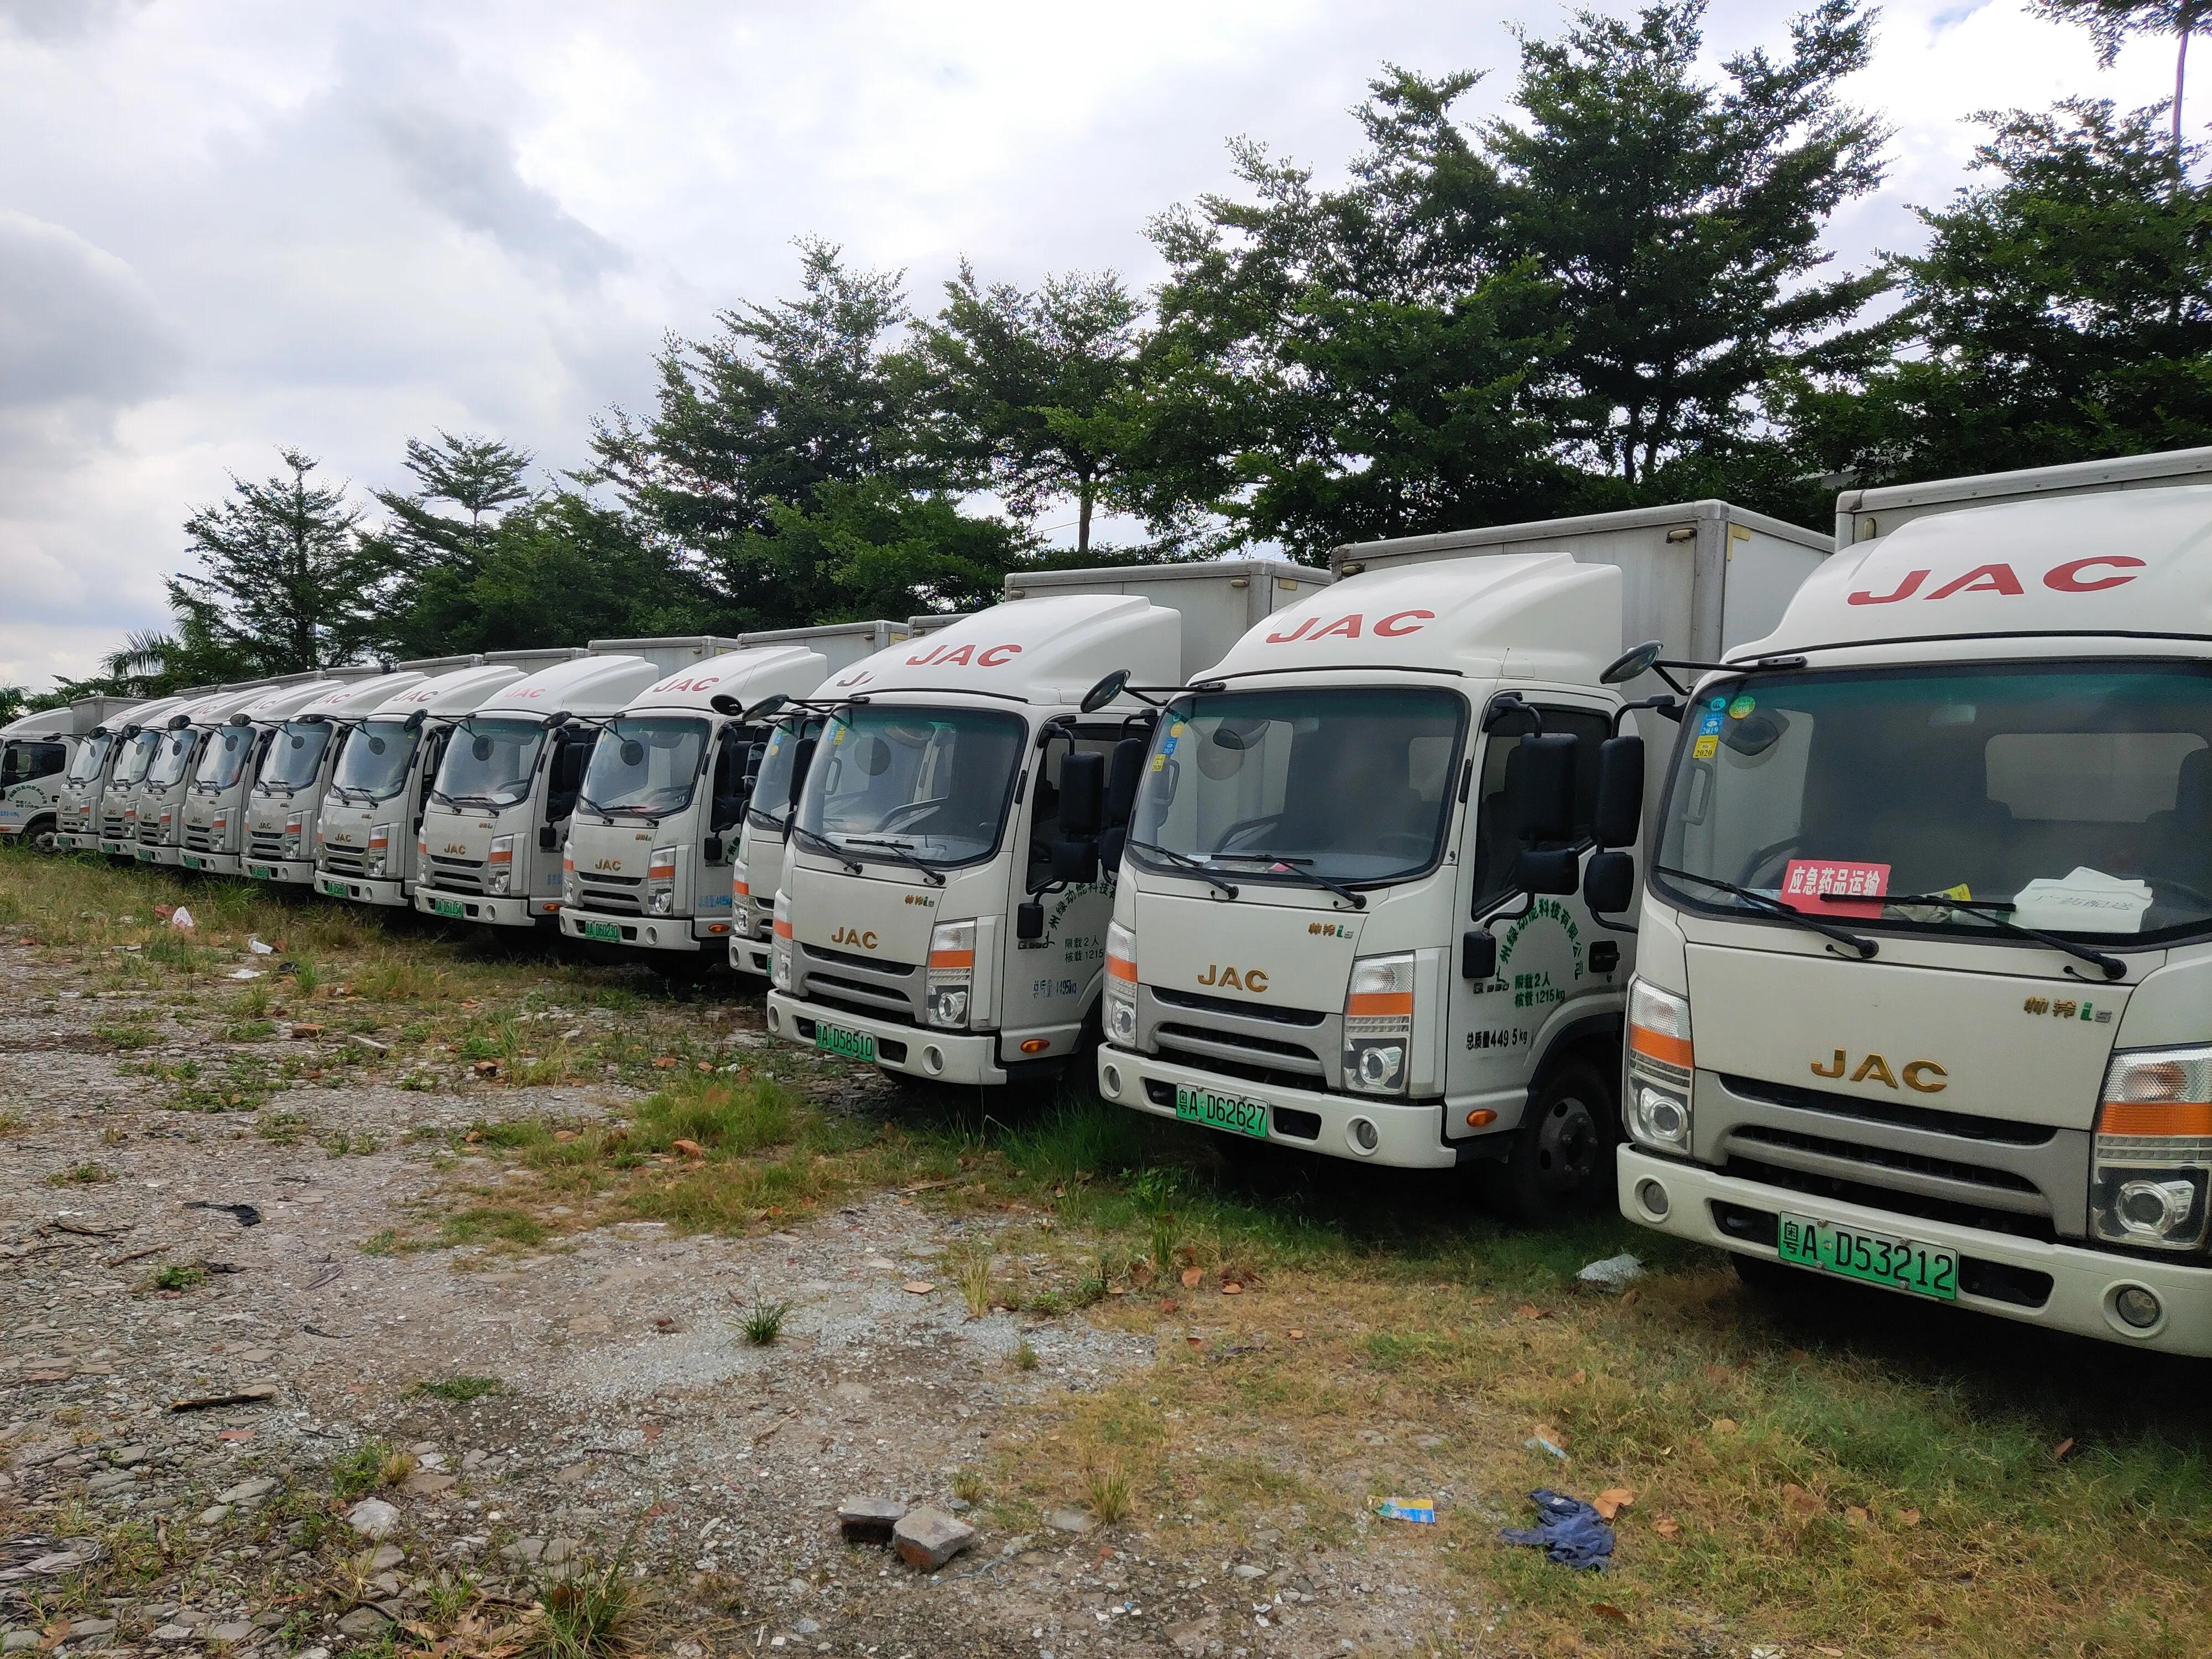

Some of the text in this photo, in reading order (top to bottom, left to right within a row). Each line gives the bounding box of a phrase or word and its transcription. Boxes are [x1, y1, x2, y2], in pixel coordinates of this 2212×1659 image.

[1848, 556, 2147, 605] JAC
[1266, 610, 1435, 643] JAC
[906, 644, 1022, 666] JAC
[653, 677, 719, 692] JAC
[312, 693, 351, 704] JAC
[392, 691, 439, 702] JAC
[504, 688, 546, 698] JAC
[244, 700, 275, 710] JAC
[1701, 727, 1719, 735] 2019
[258, 821, 272, 830] JAC
[335, 833, 352, 843] JAC
[444, 843, 466, 855] JAC
[594, 858, 622, 872] JAC
[1787, 866, 1880, 896] 应急药品运输
[831, 927, 878, 949] JAC
[1197, 964, 1269, 993] JAC
[1811, 1048, 1948, 1093] JAC
